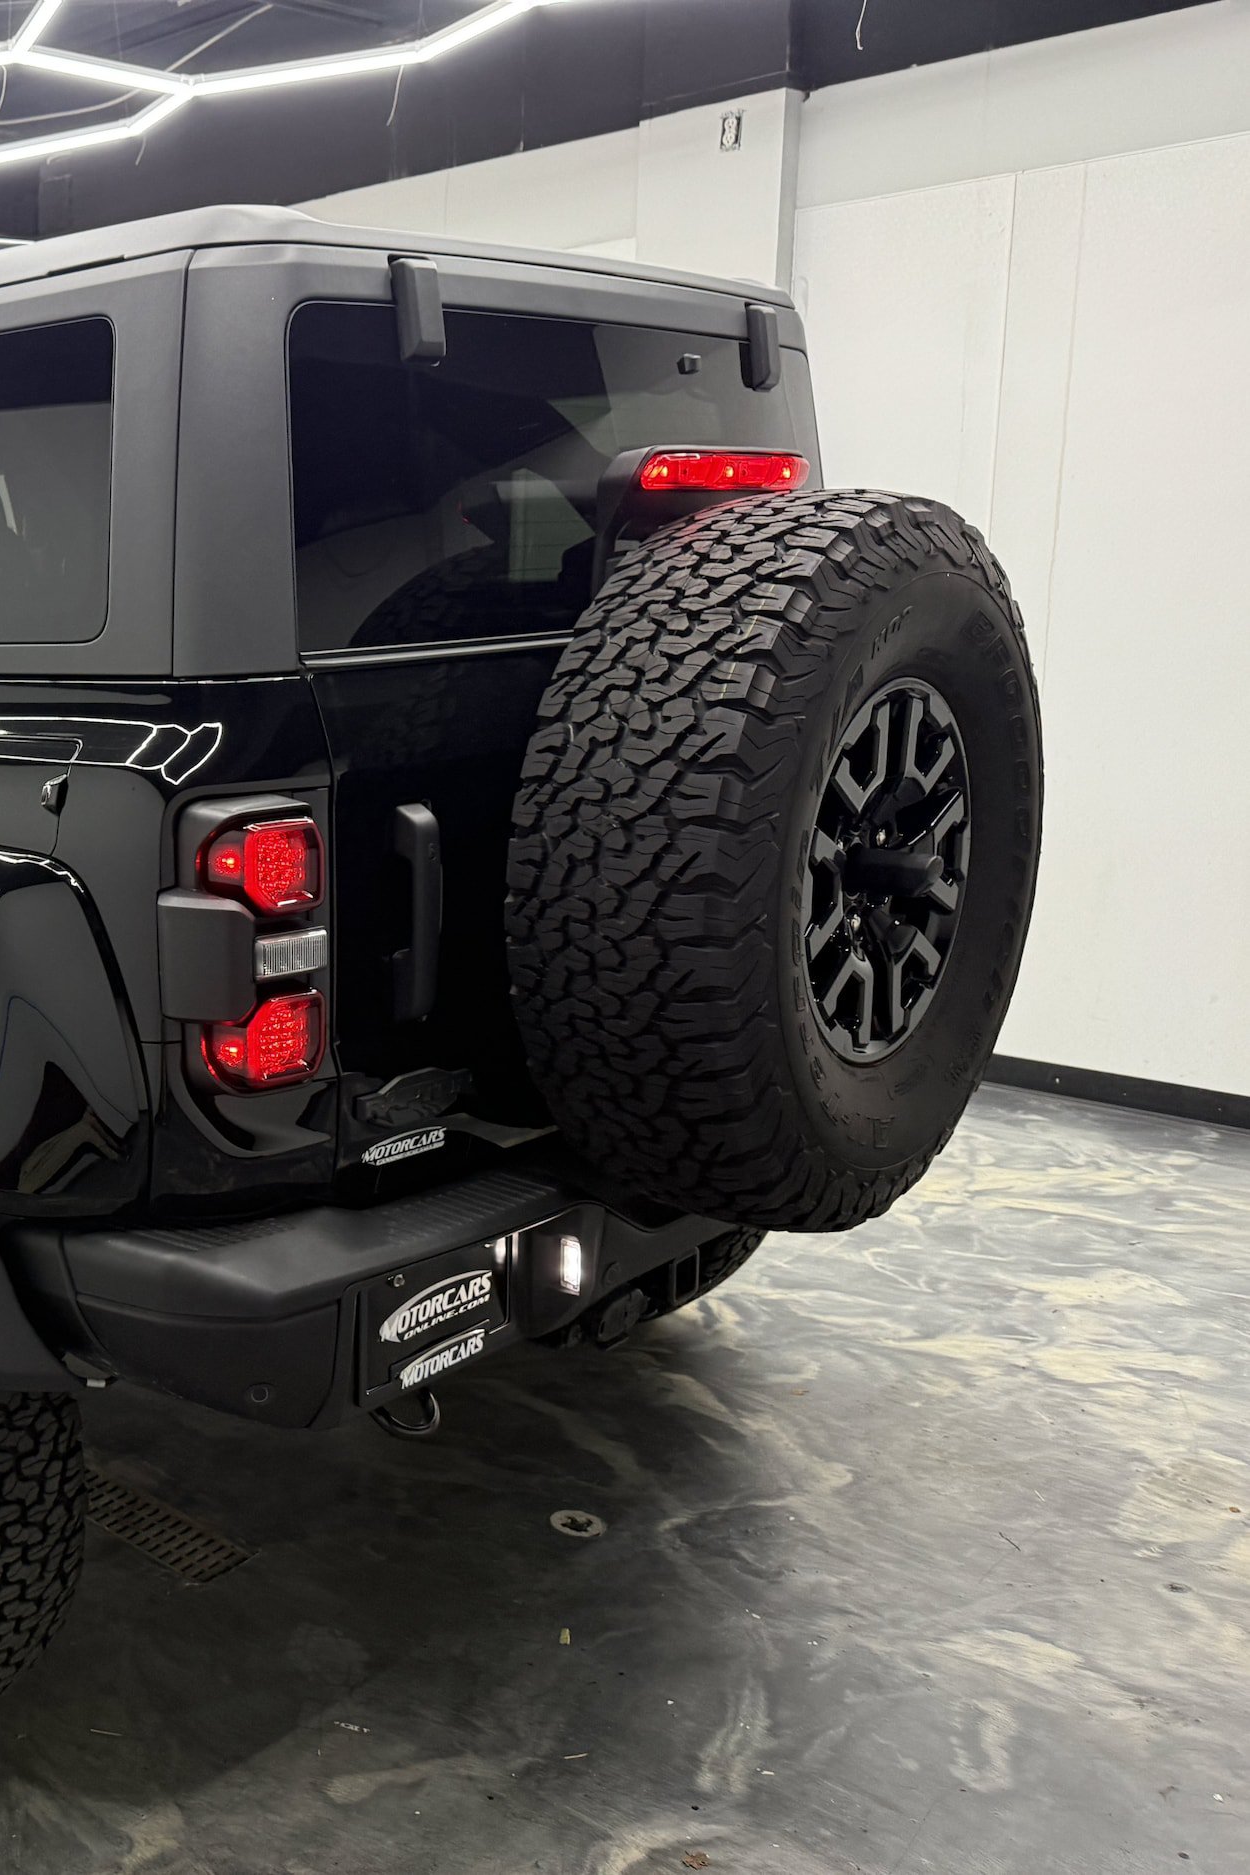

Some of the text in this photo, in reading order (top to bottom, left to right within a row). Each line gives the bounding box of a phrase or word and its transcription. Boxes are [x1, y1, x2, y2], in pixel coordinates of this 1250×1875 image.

[361, 1127, 447, 1164] MOTORCARS
[379, 1271, 493, 1343] MOTORCARS
[403, 1293, 491, 1341] ONLINE.COM
[400, 1333, 486, 1390] MOTORCARS
